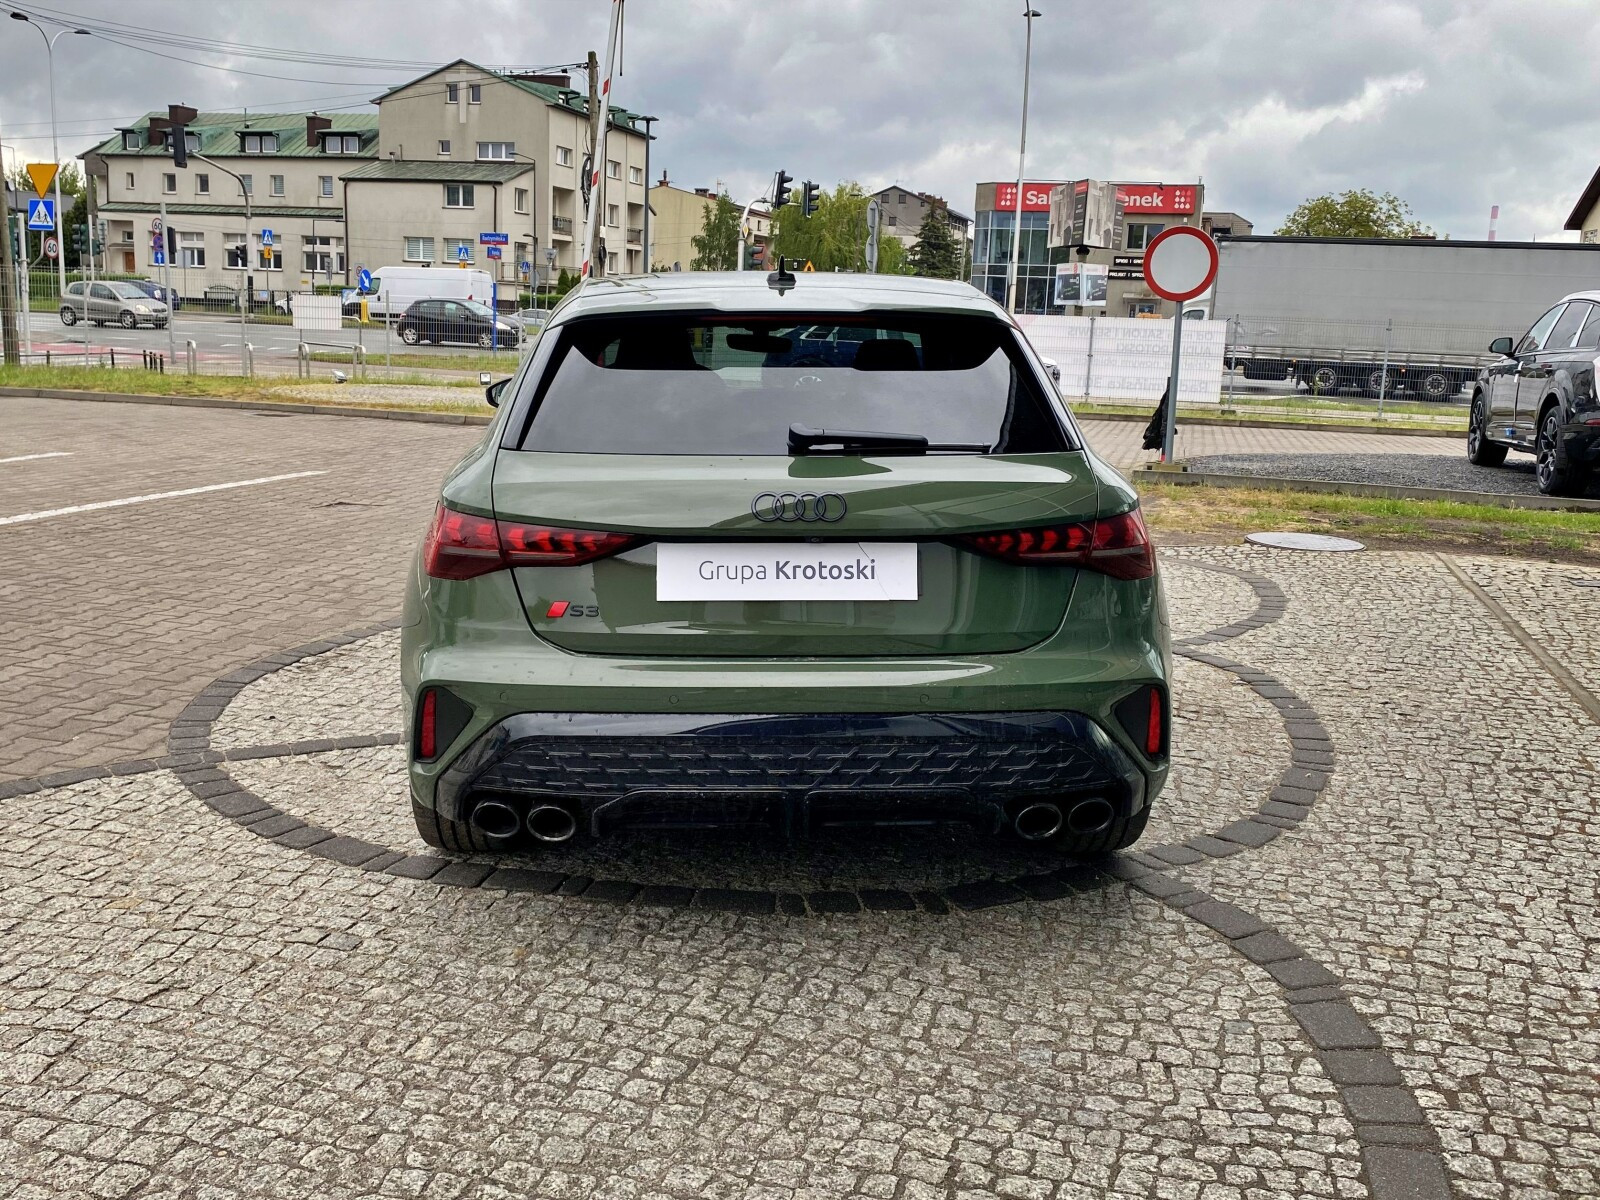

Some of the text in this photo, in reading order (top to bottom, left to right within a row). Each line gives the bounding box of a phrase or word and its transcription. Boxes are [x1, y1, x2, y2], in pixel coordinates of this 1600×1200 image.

[1026, 190, 1052, 205] Sal
[154, 222, 163, 231] 60
[48, 242, 57, 253] 60
[699, 558, 876, 584] Grupa Krotoski
[569, 604, 600, 618] S3
